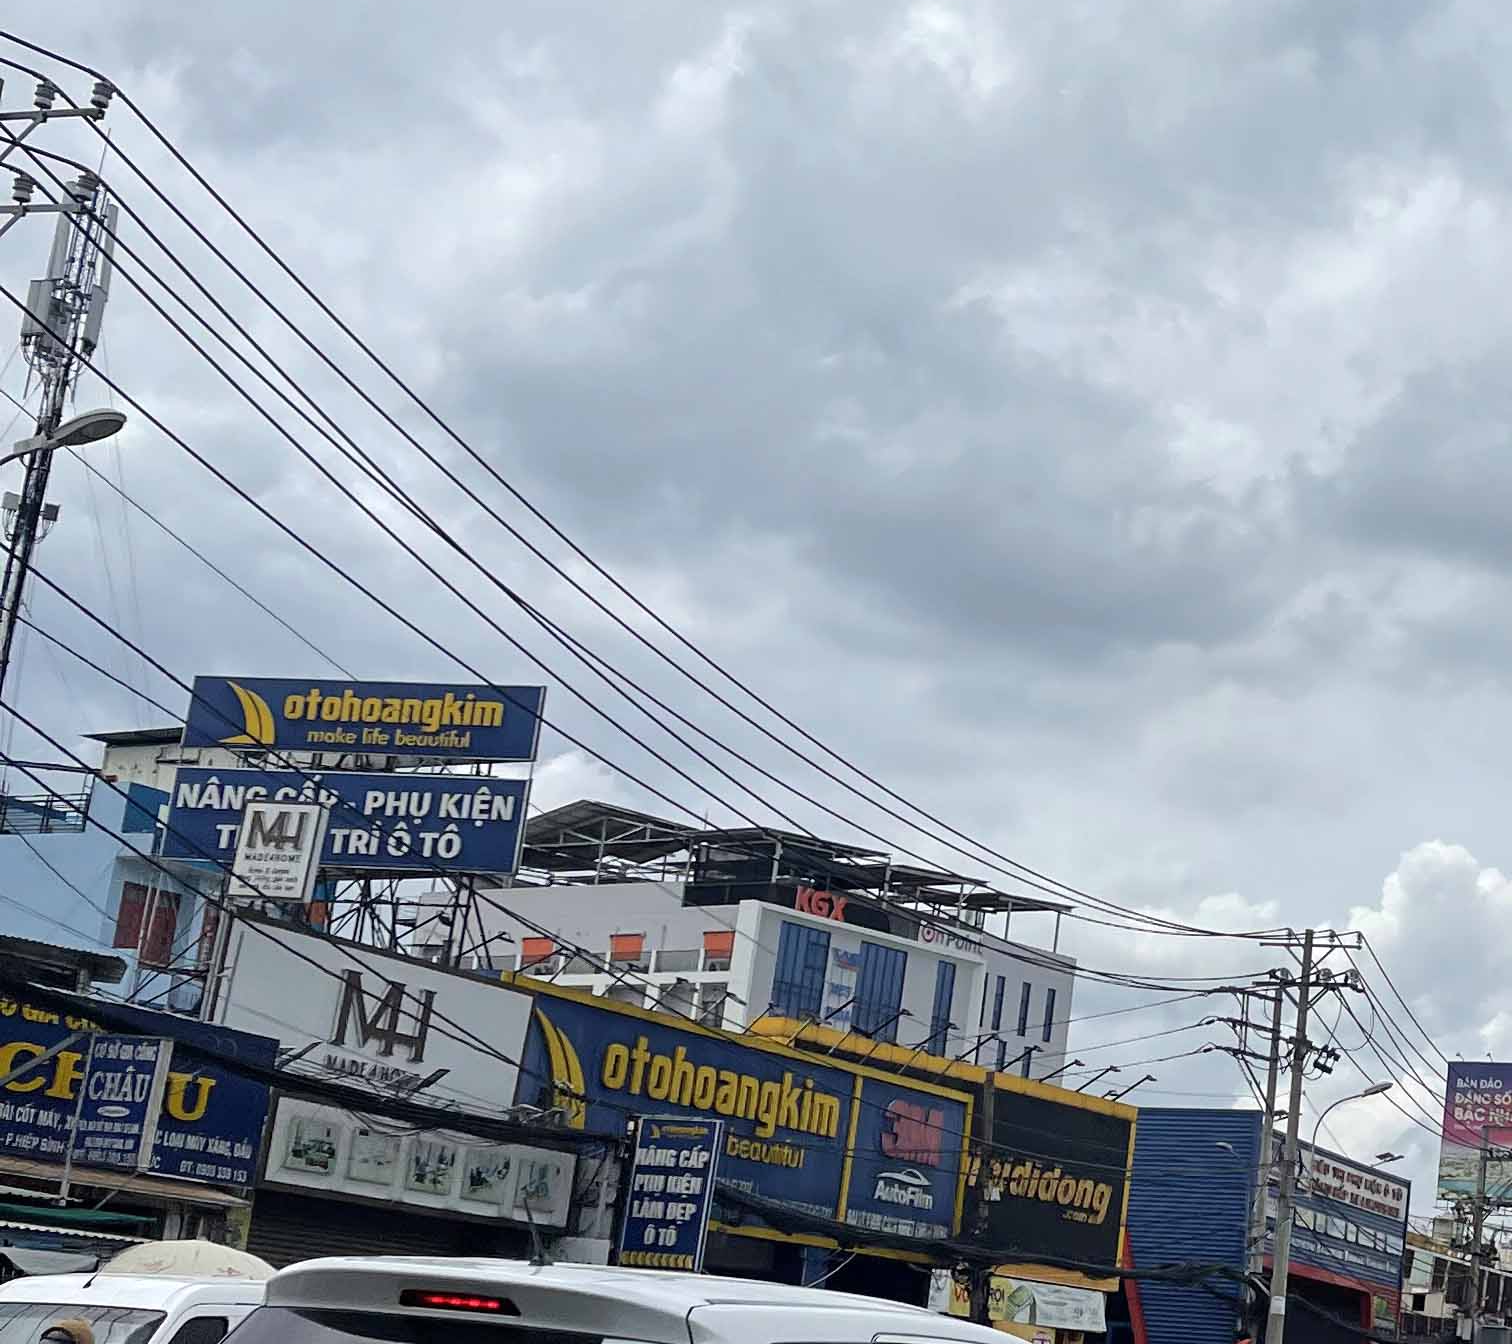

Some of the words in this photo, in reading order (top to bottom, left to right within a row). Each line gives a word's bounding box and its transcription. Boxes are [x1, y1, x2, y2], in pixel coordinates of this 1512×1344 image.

[283, 688, 504, 733] otohoangkim
[307, 729, 355, 745] make
[362, 727, 388, 745] life
[394, 729, 471, 749] beautiful
[363, 790, 432, 825] PHỤ
[439, 786, 515, 828] KIỆN
[419, 823, 462, 860] TÔ
[794, 885, 849, 922] KGX
[602, 1034, 840, 1139] otohoangkim
[873, 1179, 934, 1210] AutoFilm
[658, 1224, 678, 1247] TÔ
